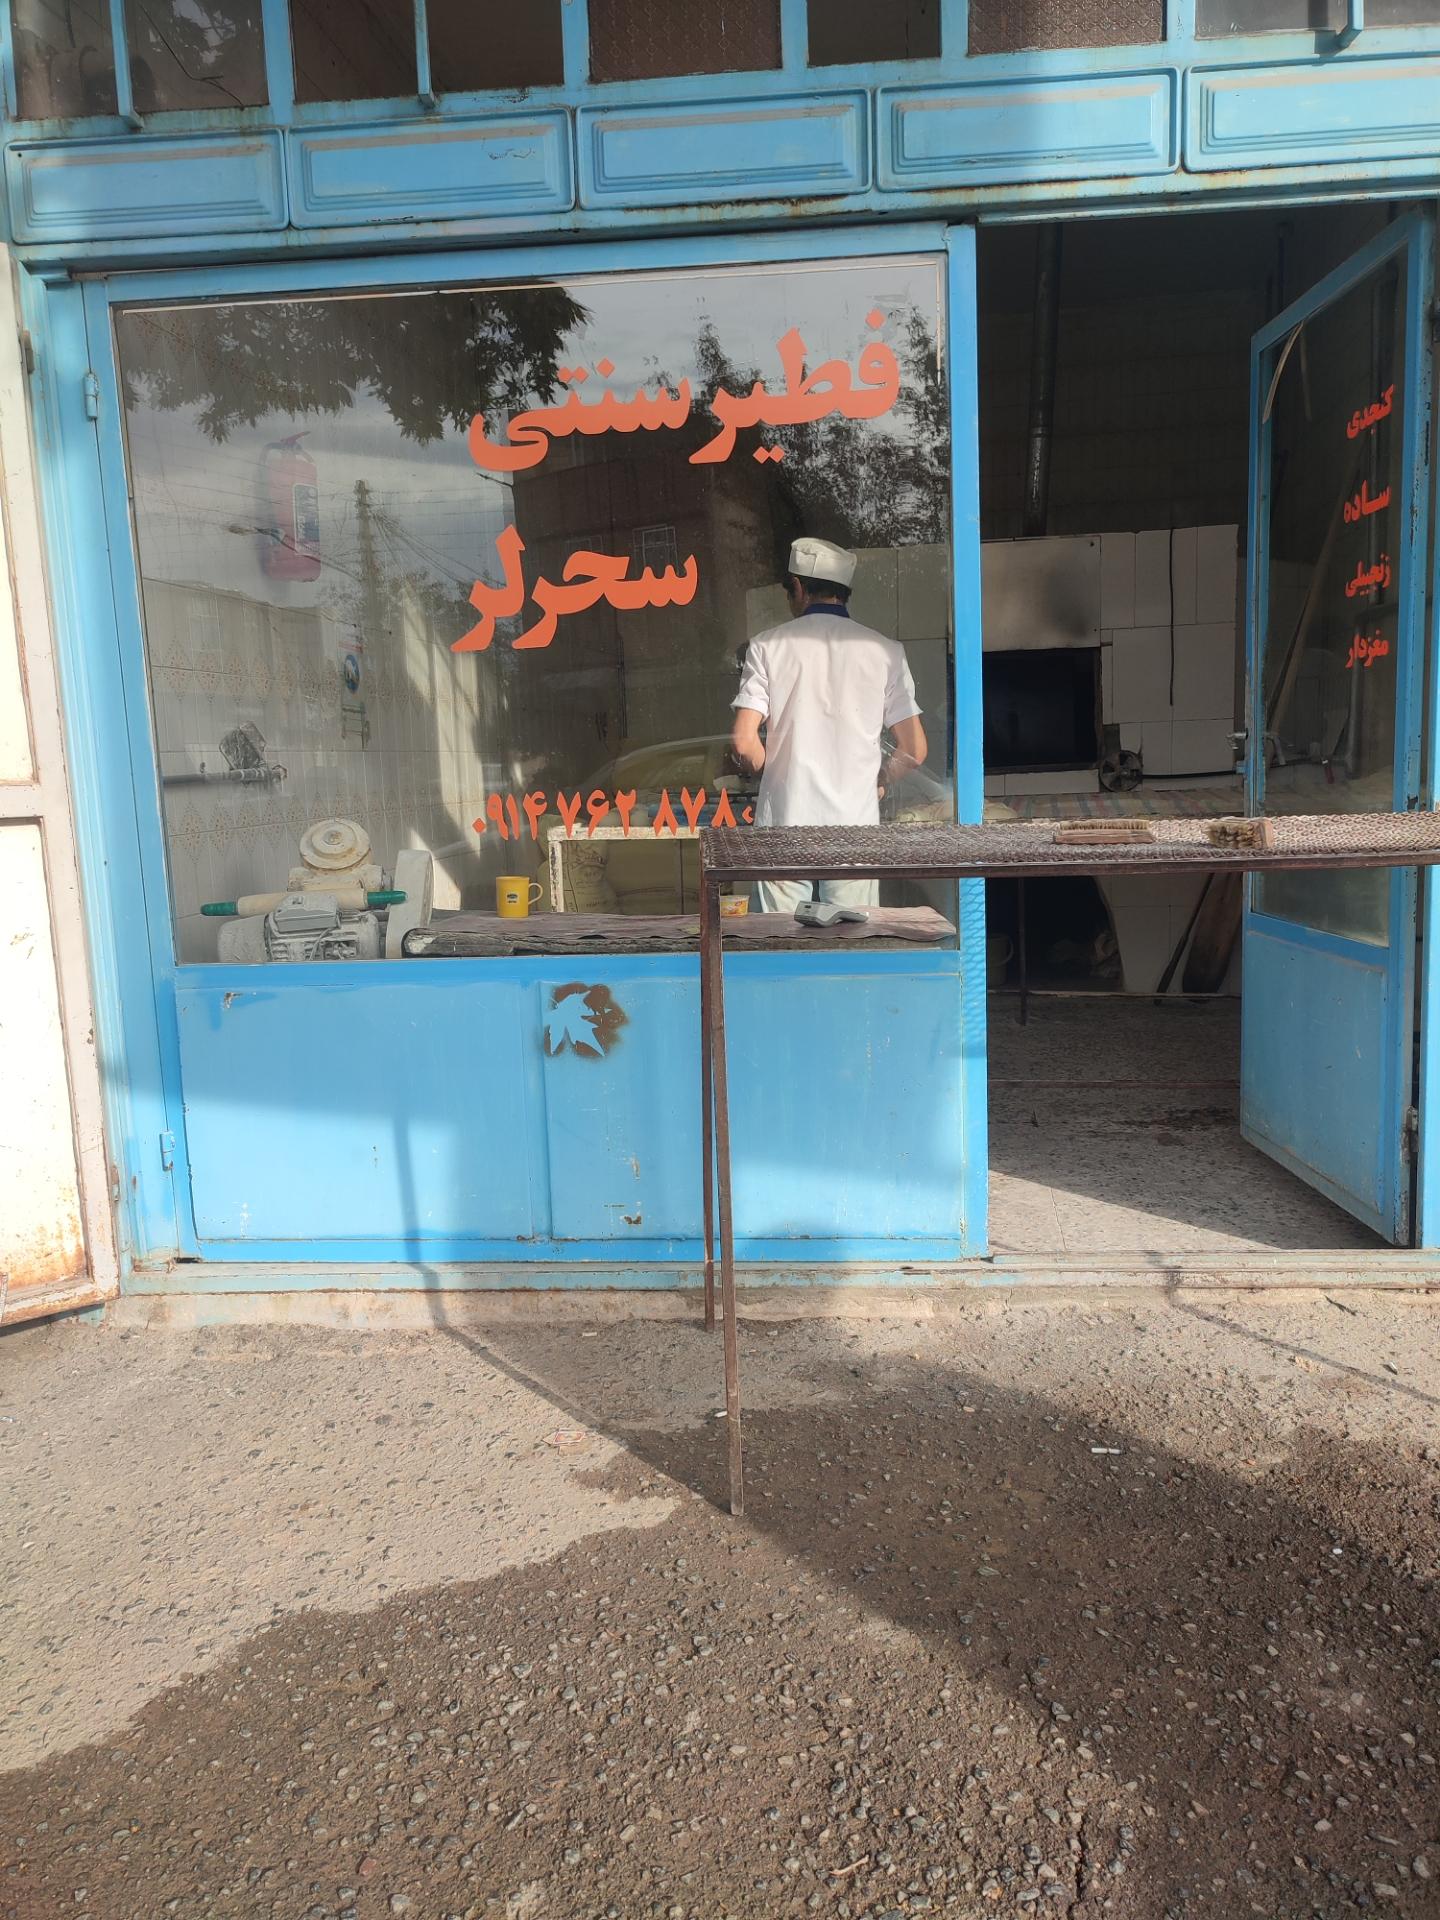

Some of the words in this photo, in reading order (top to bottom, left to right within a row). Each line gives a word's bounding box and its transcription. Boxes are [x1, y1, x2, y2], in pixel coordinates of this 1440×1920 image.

[688, 308, 902, 465] فطیر
[468, 357, 692, 473] سنتی
[1346, 384, 1394, 439] کنجدی
[1343, 480, 1392, 523] ساده
[1344, 553, 1391, 597] زنجبیلی
[1344, 629, 1390, 668] مغزدار
